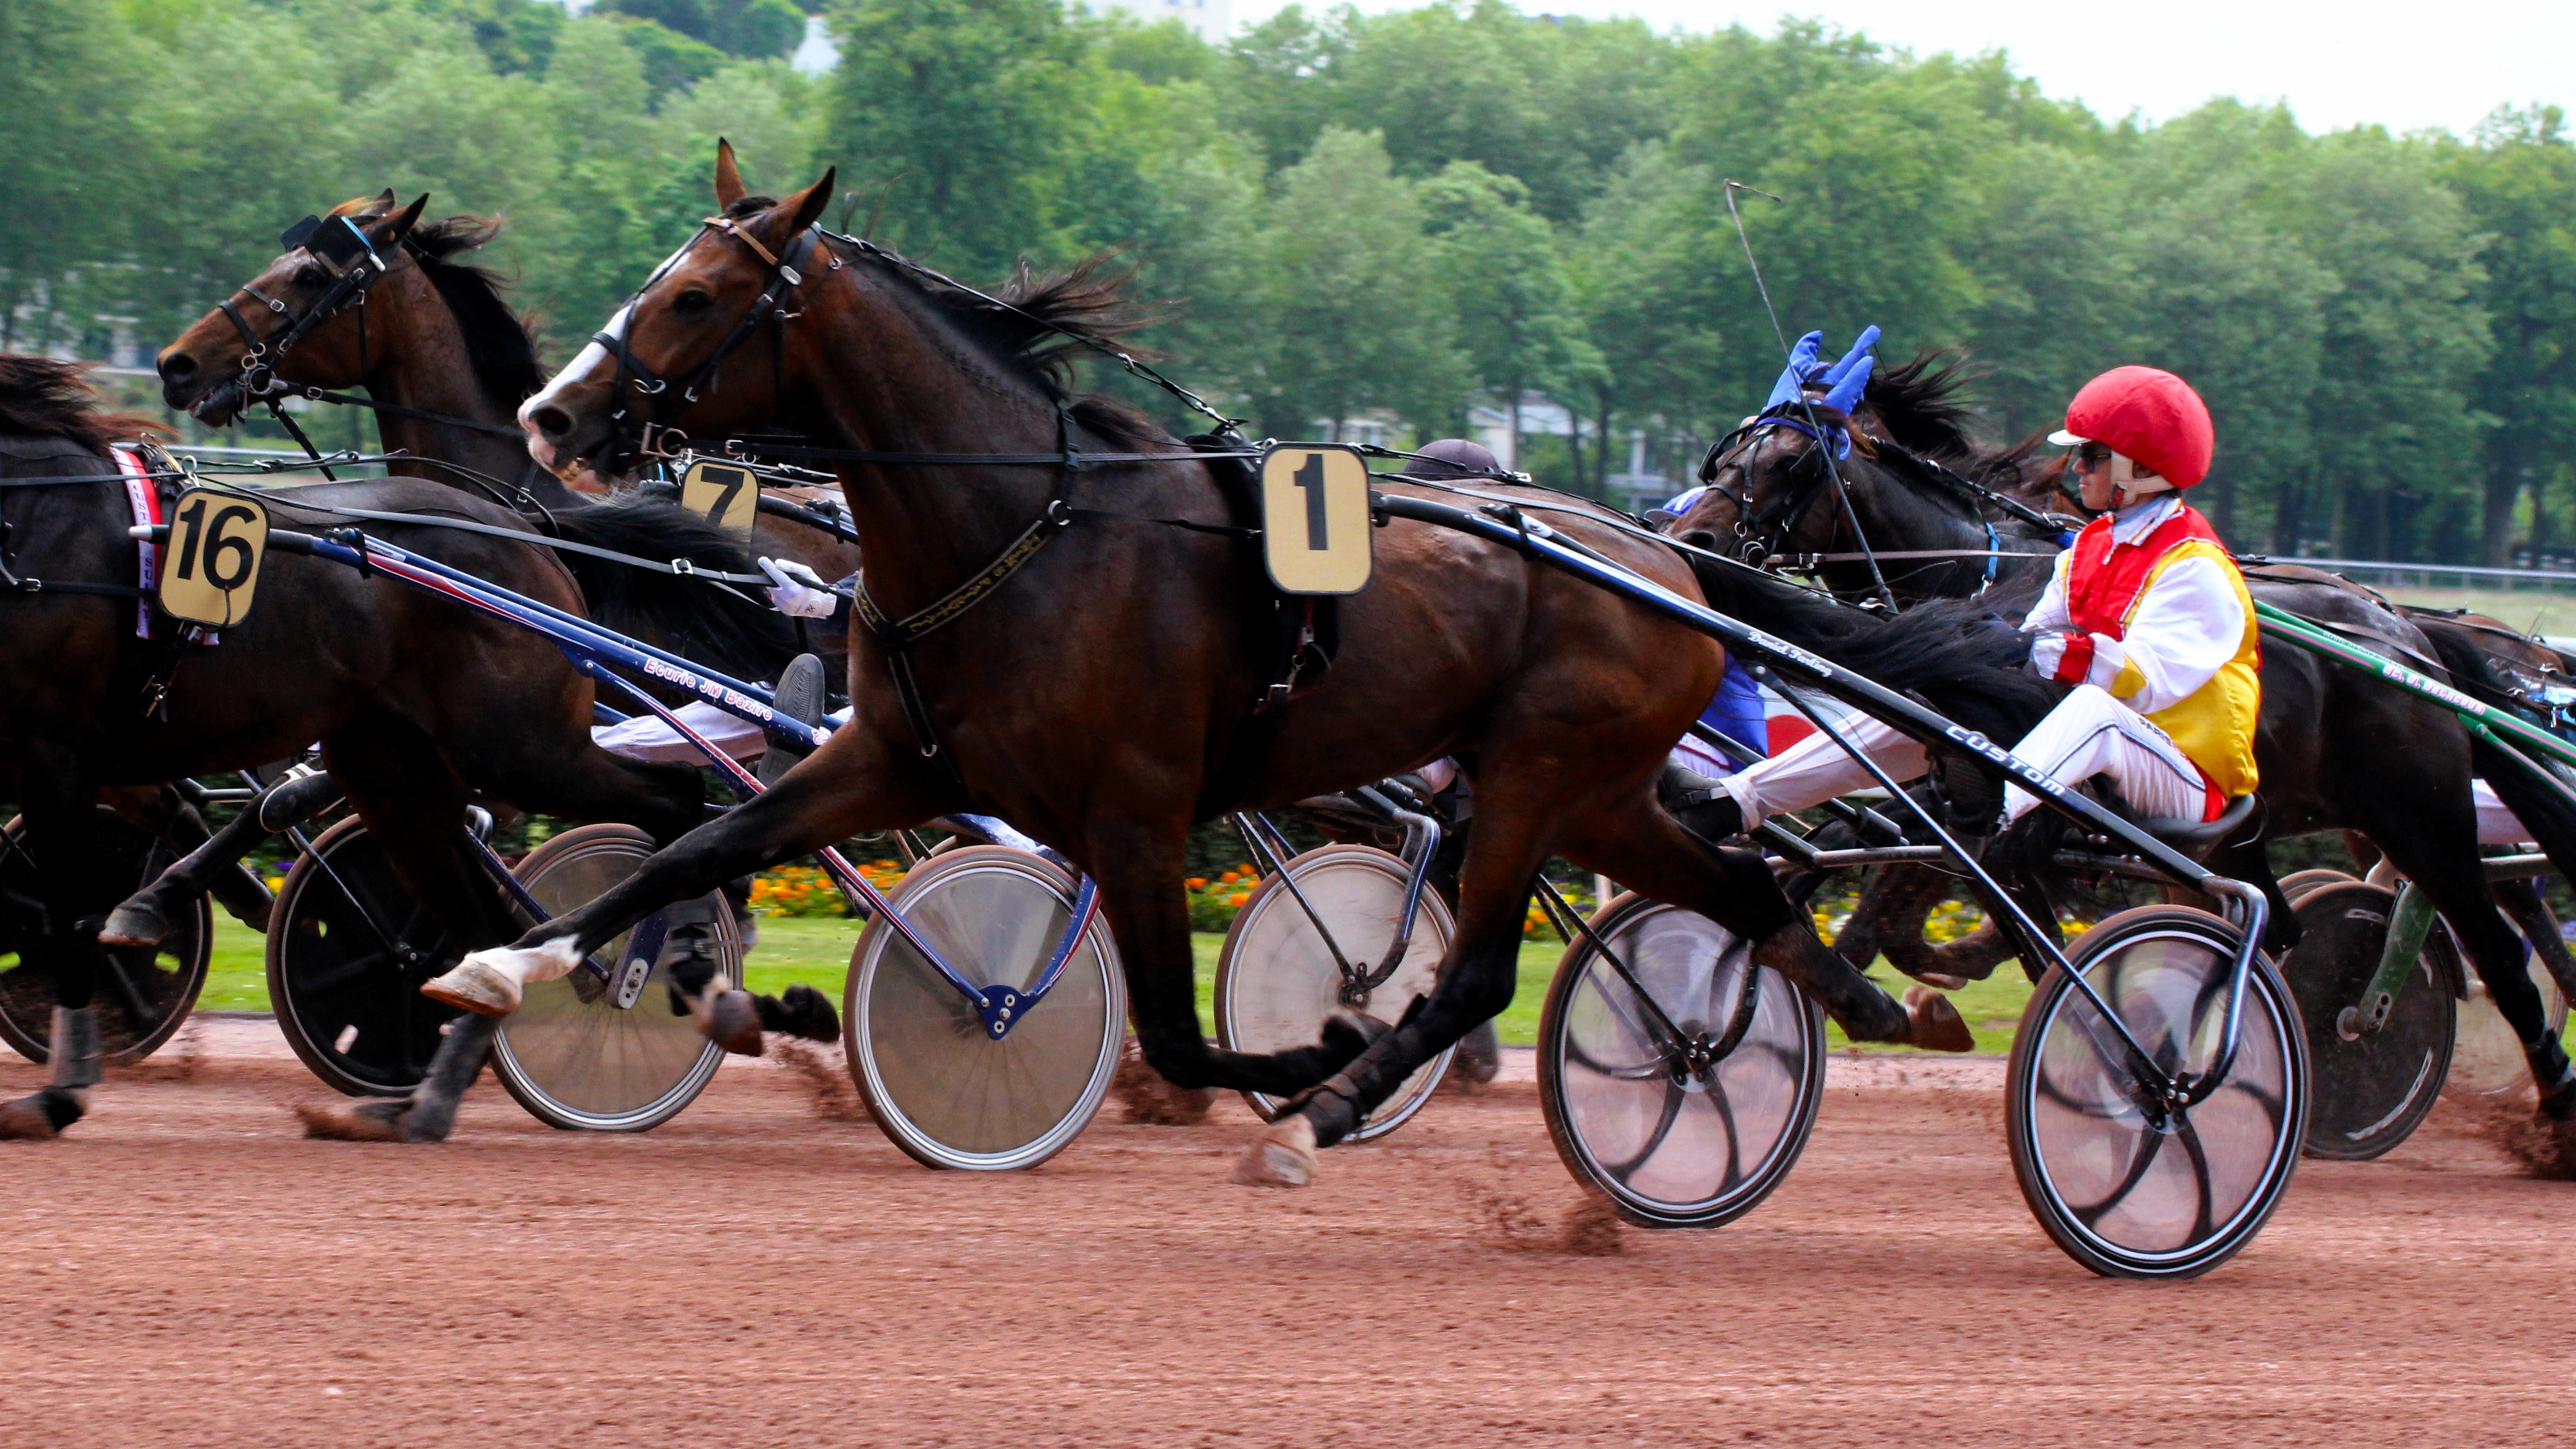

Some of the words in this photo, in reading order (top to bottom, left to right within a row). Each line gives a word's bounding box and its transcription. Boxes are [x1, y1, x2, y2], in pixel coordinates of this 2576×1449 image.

[133, 485, 148, 526] CUST
[700, 465, 745, 526] 7
[1293, 454, 1328, 550] 1
[178, 499, 257, 590] 16
[1747, 631, 1790, 655] Daniel
[644, 658, 696, 688] Ecurie
[699, 680, 723, 699] JM
[725, 688, 772, 720] Bazire
[1945, 726, 2066, 797] CUSTOM
